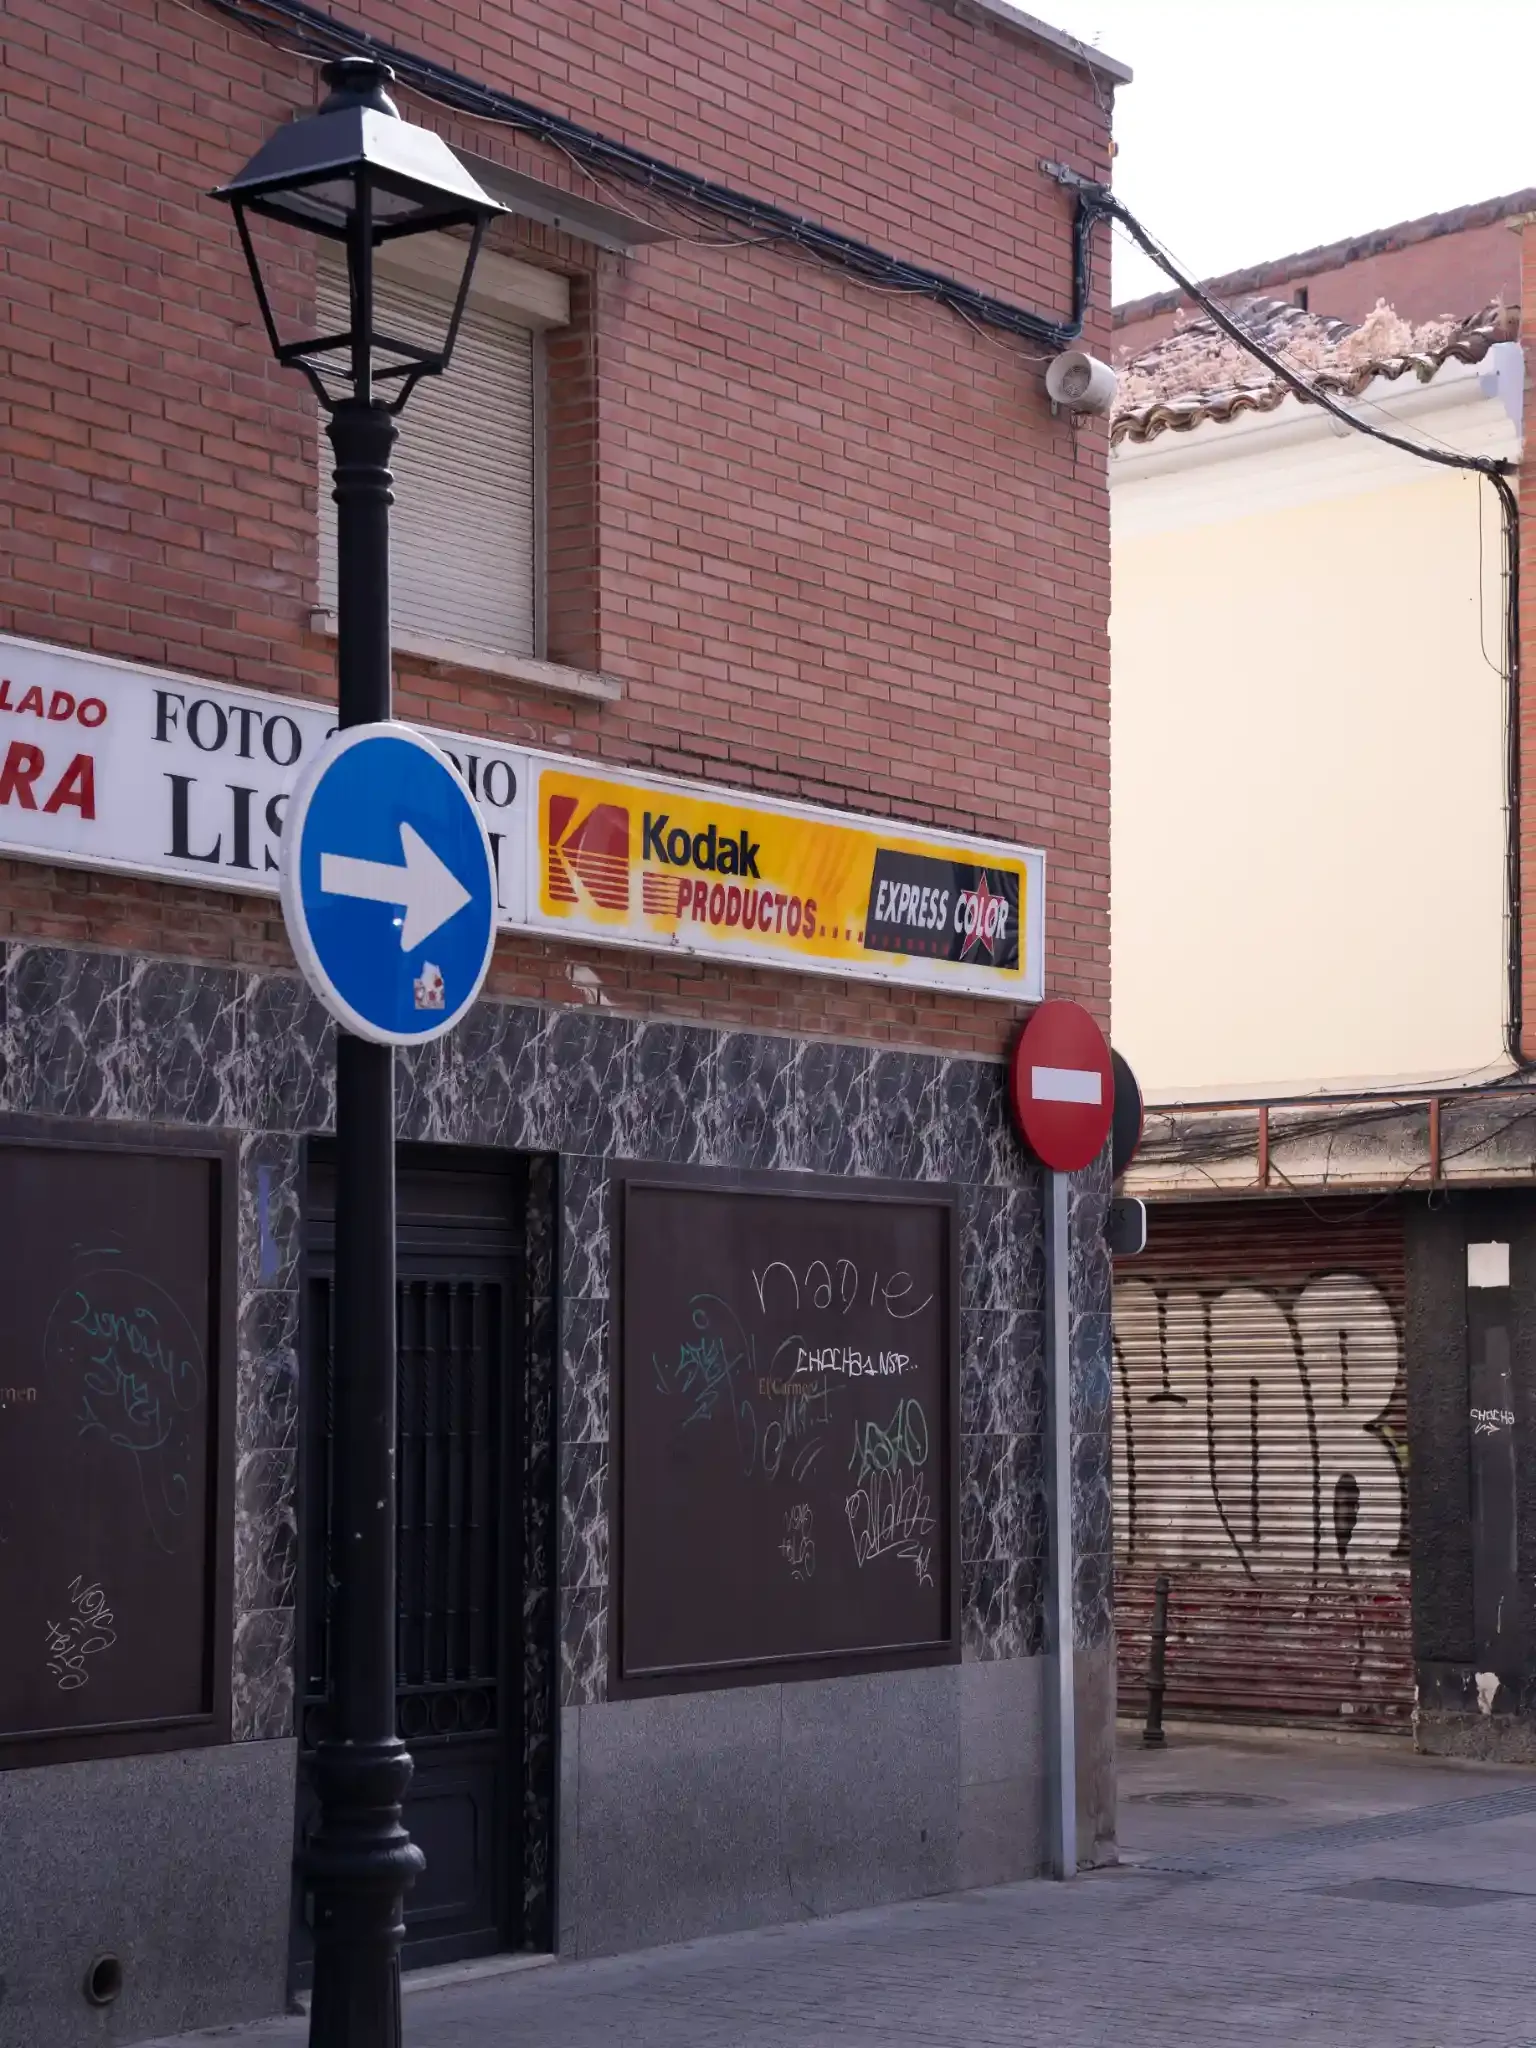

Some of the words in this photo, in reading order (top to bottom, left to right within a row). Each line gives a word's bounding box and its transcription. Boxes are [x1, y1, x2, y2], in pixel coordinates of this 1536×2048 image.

[151, 689, 302, 766] FOTO
[0, 741, 96, 820] RA
[643, 812, 761, 879] Kodak
[874, 879, 950, 931] EXPRESS
[953, 893, 1009, 940] COLOR
